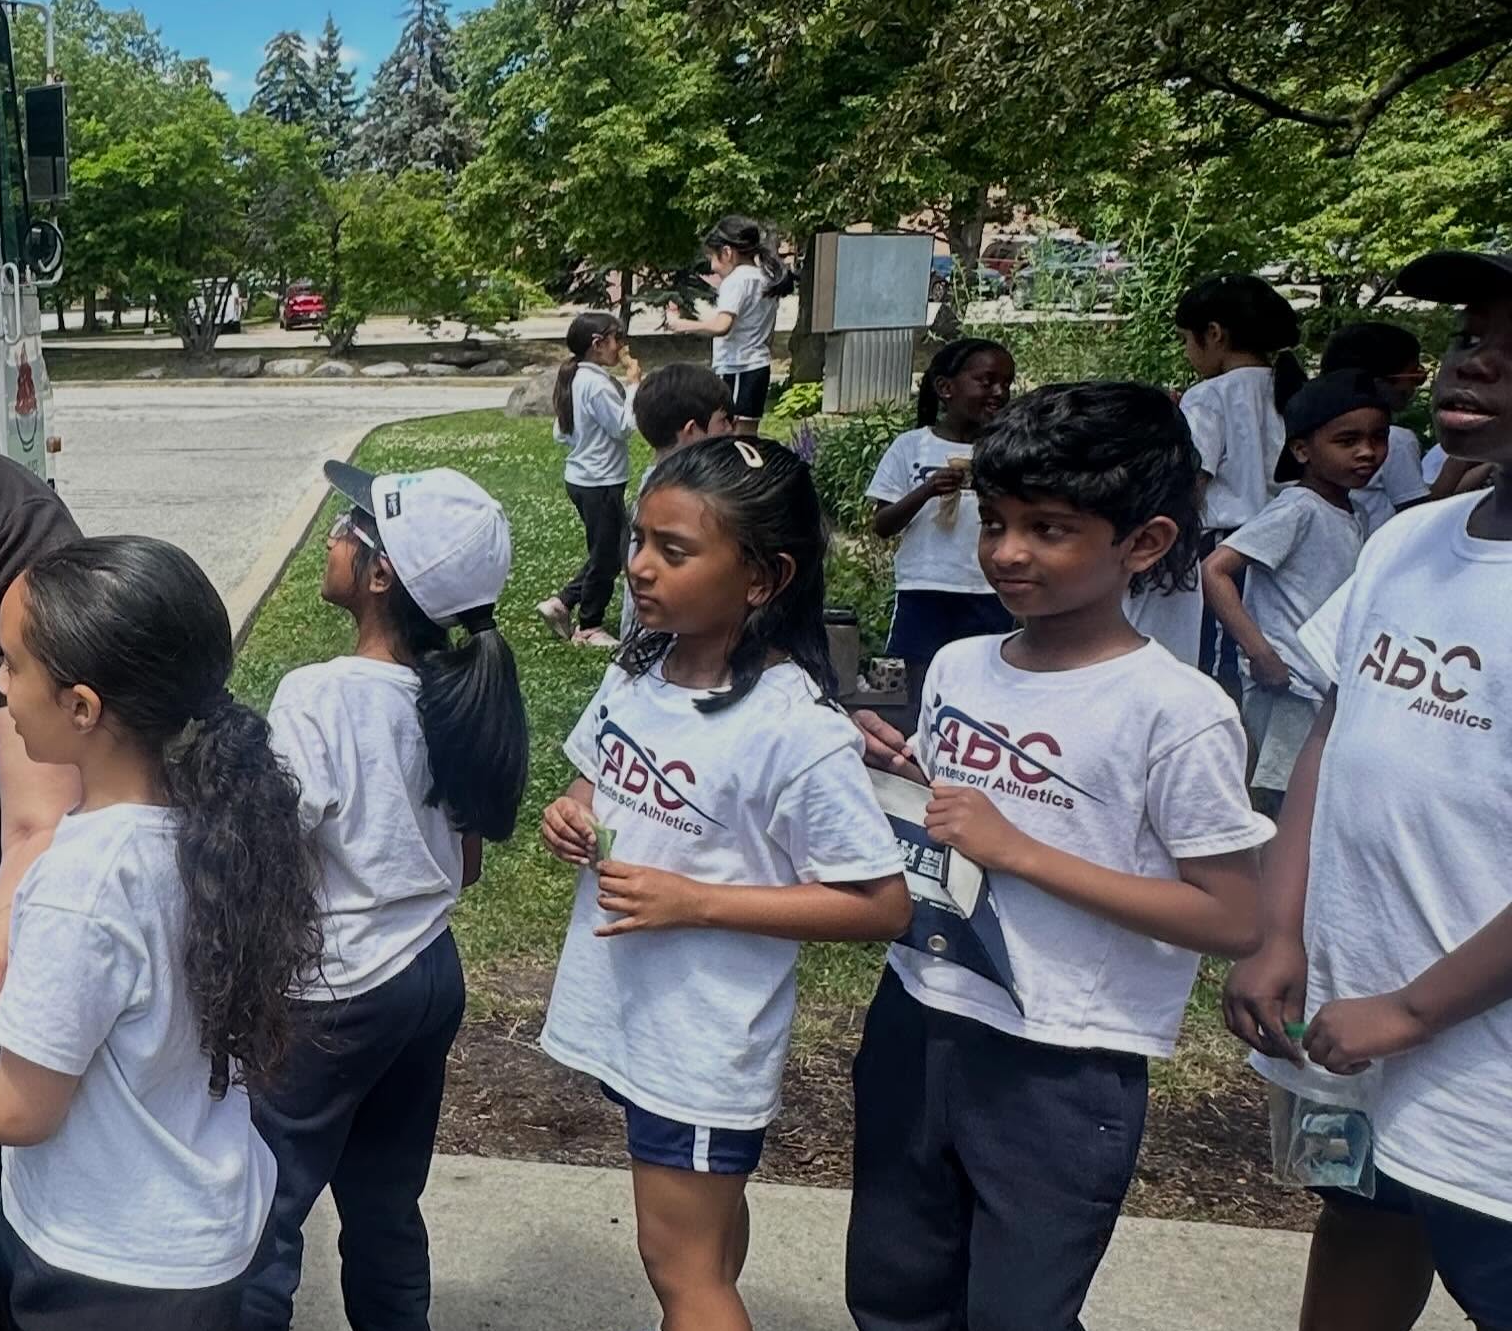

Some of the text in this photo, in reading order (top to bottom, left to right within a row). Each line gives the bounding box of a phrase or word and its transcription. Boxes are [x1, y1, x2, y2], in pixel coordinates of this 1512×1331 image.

[1357, 632, 1481, 703] ABC
[1407, 696, 1493, 731] Athletics
[601, 740, 696, 811] ABC
[935, 720, 1062, 784] ABC
[934, 765, 1075, 810] ontessori Athletics
[638, 802, 703, 836] Athletics
